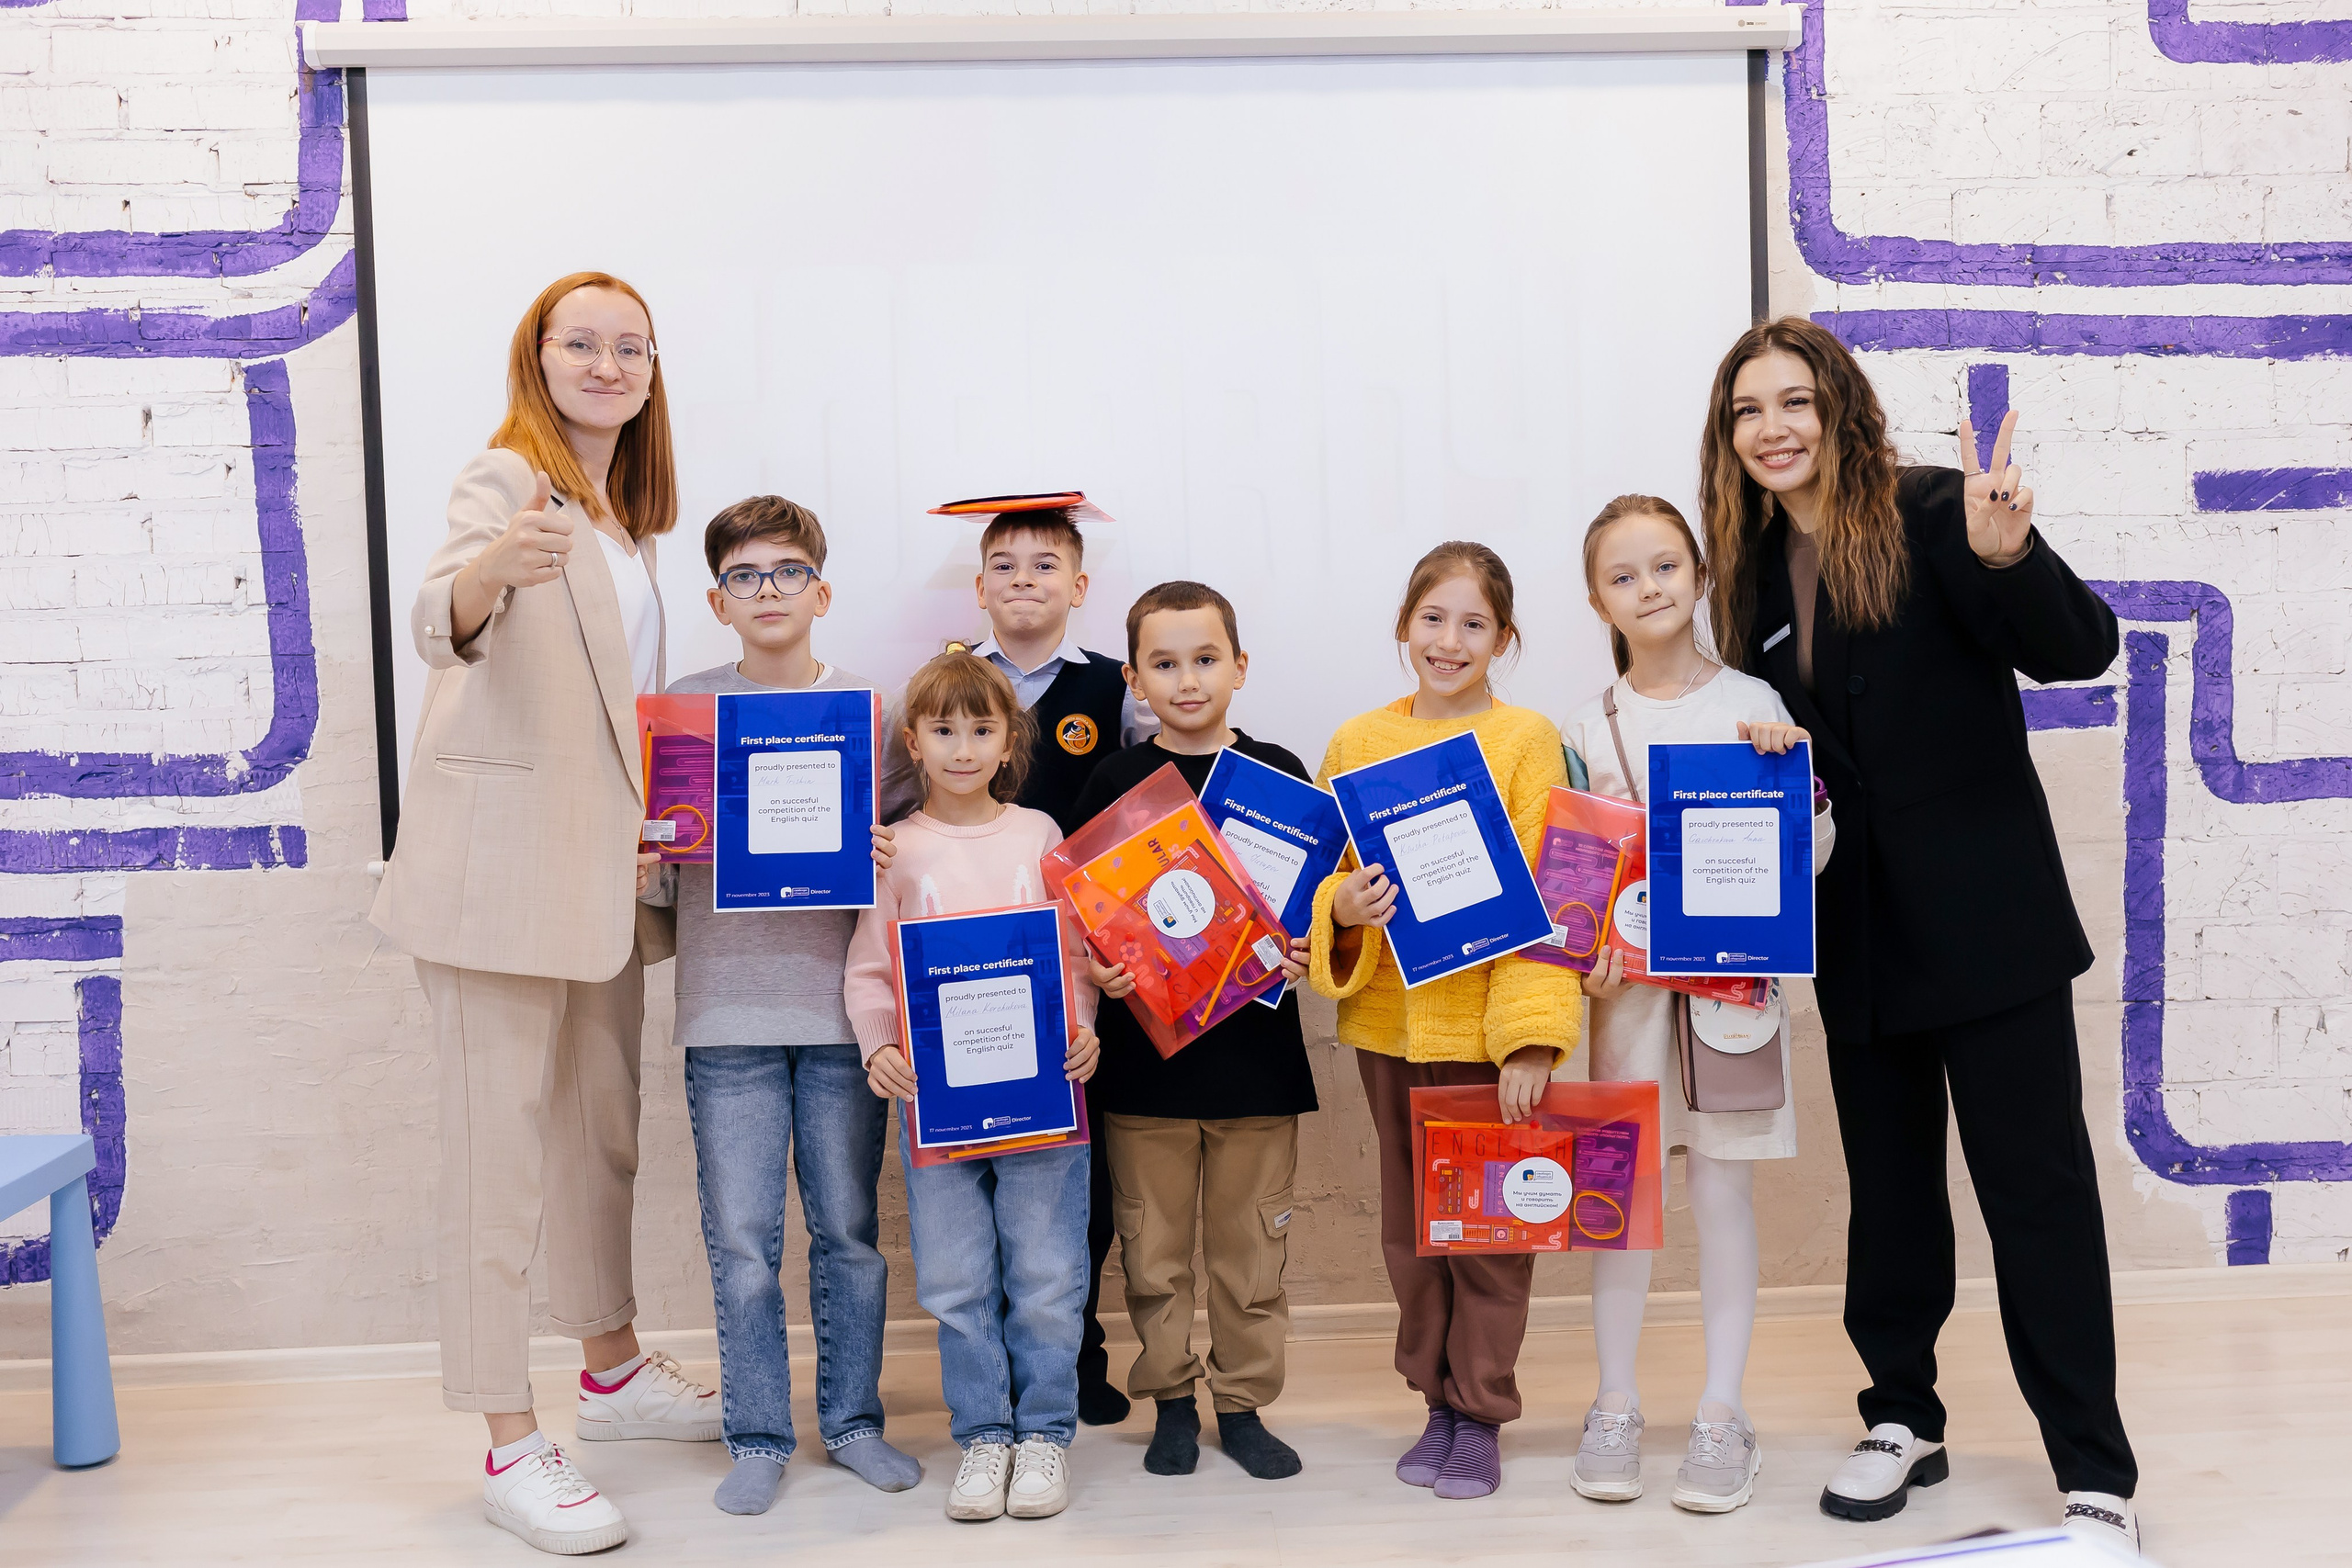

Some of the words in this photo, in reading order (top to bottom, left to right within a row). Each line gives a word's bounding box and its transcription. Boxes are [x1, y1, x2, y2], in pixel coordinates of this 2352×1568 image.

[741, 737, 763, 745] First
[765, 736, 793, 744] place
[795, 733, 845, 744] certificate
[754, 763, 785, 772] proudly
[786, 762, 826, 771] presented
[1673, 790, 1697, 799] First
[1699, 790, 1728, 800] place
[1730, 789, 1784, 799] certificate
[1369, 808, 1392, 822] First
[1393, 798, 1419, 815] place
[1419, 782, 1467, 805] certificate
[758, 807, 806, 816] competition
[771, 816, 799, 824] English
[801, 815, 819, 823] quiz
[1224, 797, 1247, 816] First
[1245, 808, 1272, 827] place
[1272, 819, 1319, 846] certificate
[1689, 820, 1721, 829] proudly
[1722, 820, 1766, 829] presented
[1393, 827, 1421, 843] proudly
[1421, 814, 1459, 836] presented
[1459, 811, 1468, 819] to
[1225, 829, 1254, 849] proudly
[1254, 840, 1290, 863] presented
[1290, 858, 1299, 866] to
[1419, 862, 1430, 870] on
[1430, 848, 1465, 866] succesful
[1411, 863, 1457, 883] competition
[1457, 858, 1465, 867] of
[1465, 853, 1479, 863] the
[1692, 866, 1743, 875] competition
[1754, 866, 1769, 874] the
[1426, 873, 1453, 888] English
[1454, 866, 1472, 880] quiz
[1706, 876, 1736, 885] English
[1738, 876, 1756, 885] quiz
[1265, 892, 1277, 904] the
[1489, 932, 1510, 943] Director
[928, 966, 952, 976] First
[954, 964, 981, 975] place
[983, 957, 1034, 971] certificate
[1418, 958, 1443, 970] november
[944, 993, 976, 1003] proudly
[978, 988, 1017, 1000] presented
[976, 1023, 1012, 1035] succesful
[953, 1035, 1001, 1047] competition
[1002, 1032, 1012, 1041] of
[1012, 1032, 1025, 1040] the
[966, 1043, 996, 1055] English
[997, 1043, 1013, 1053] quiz
